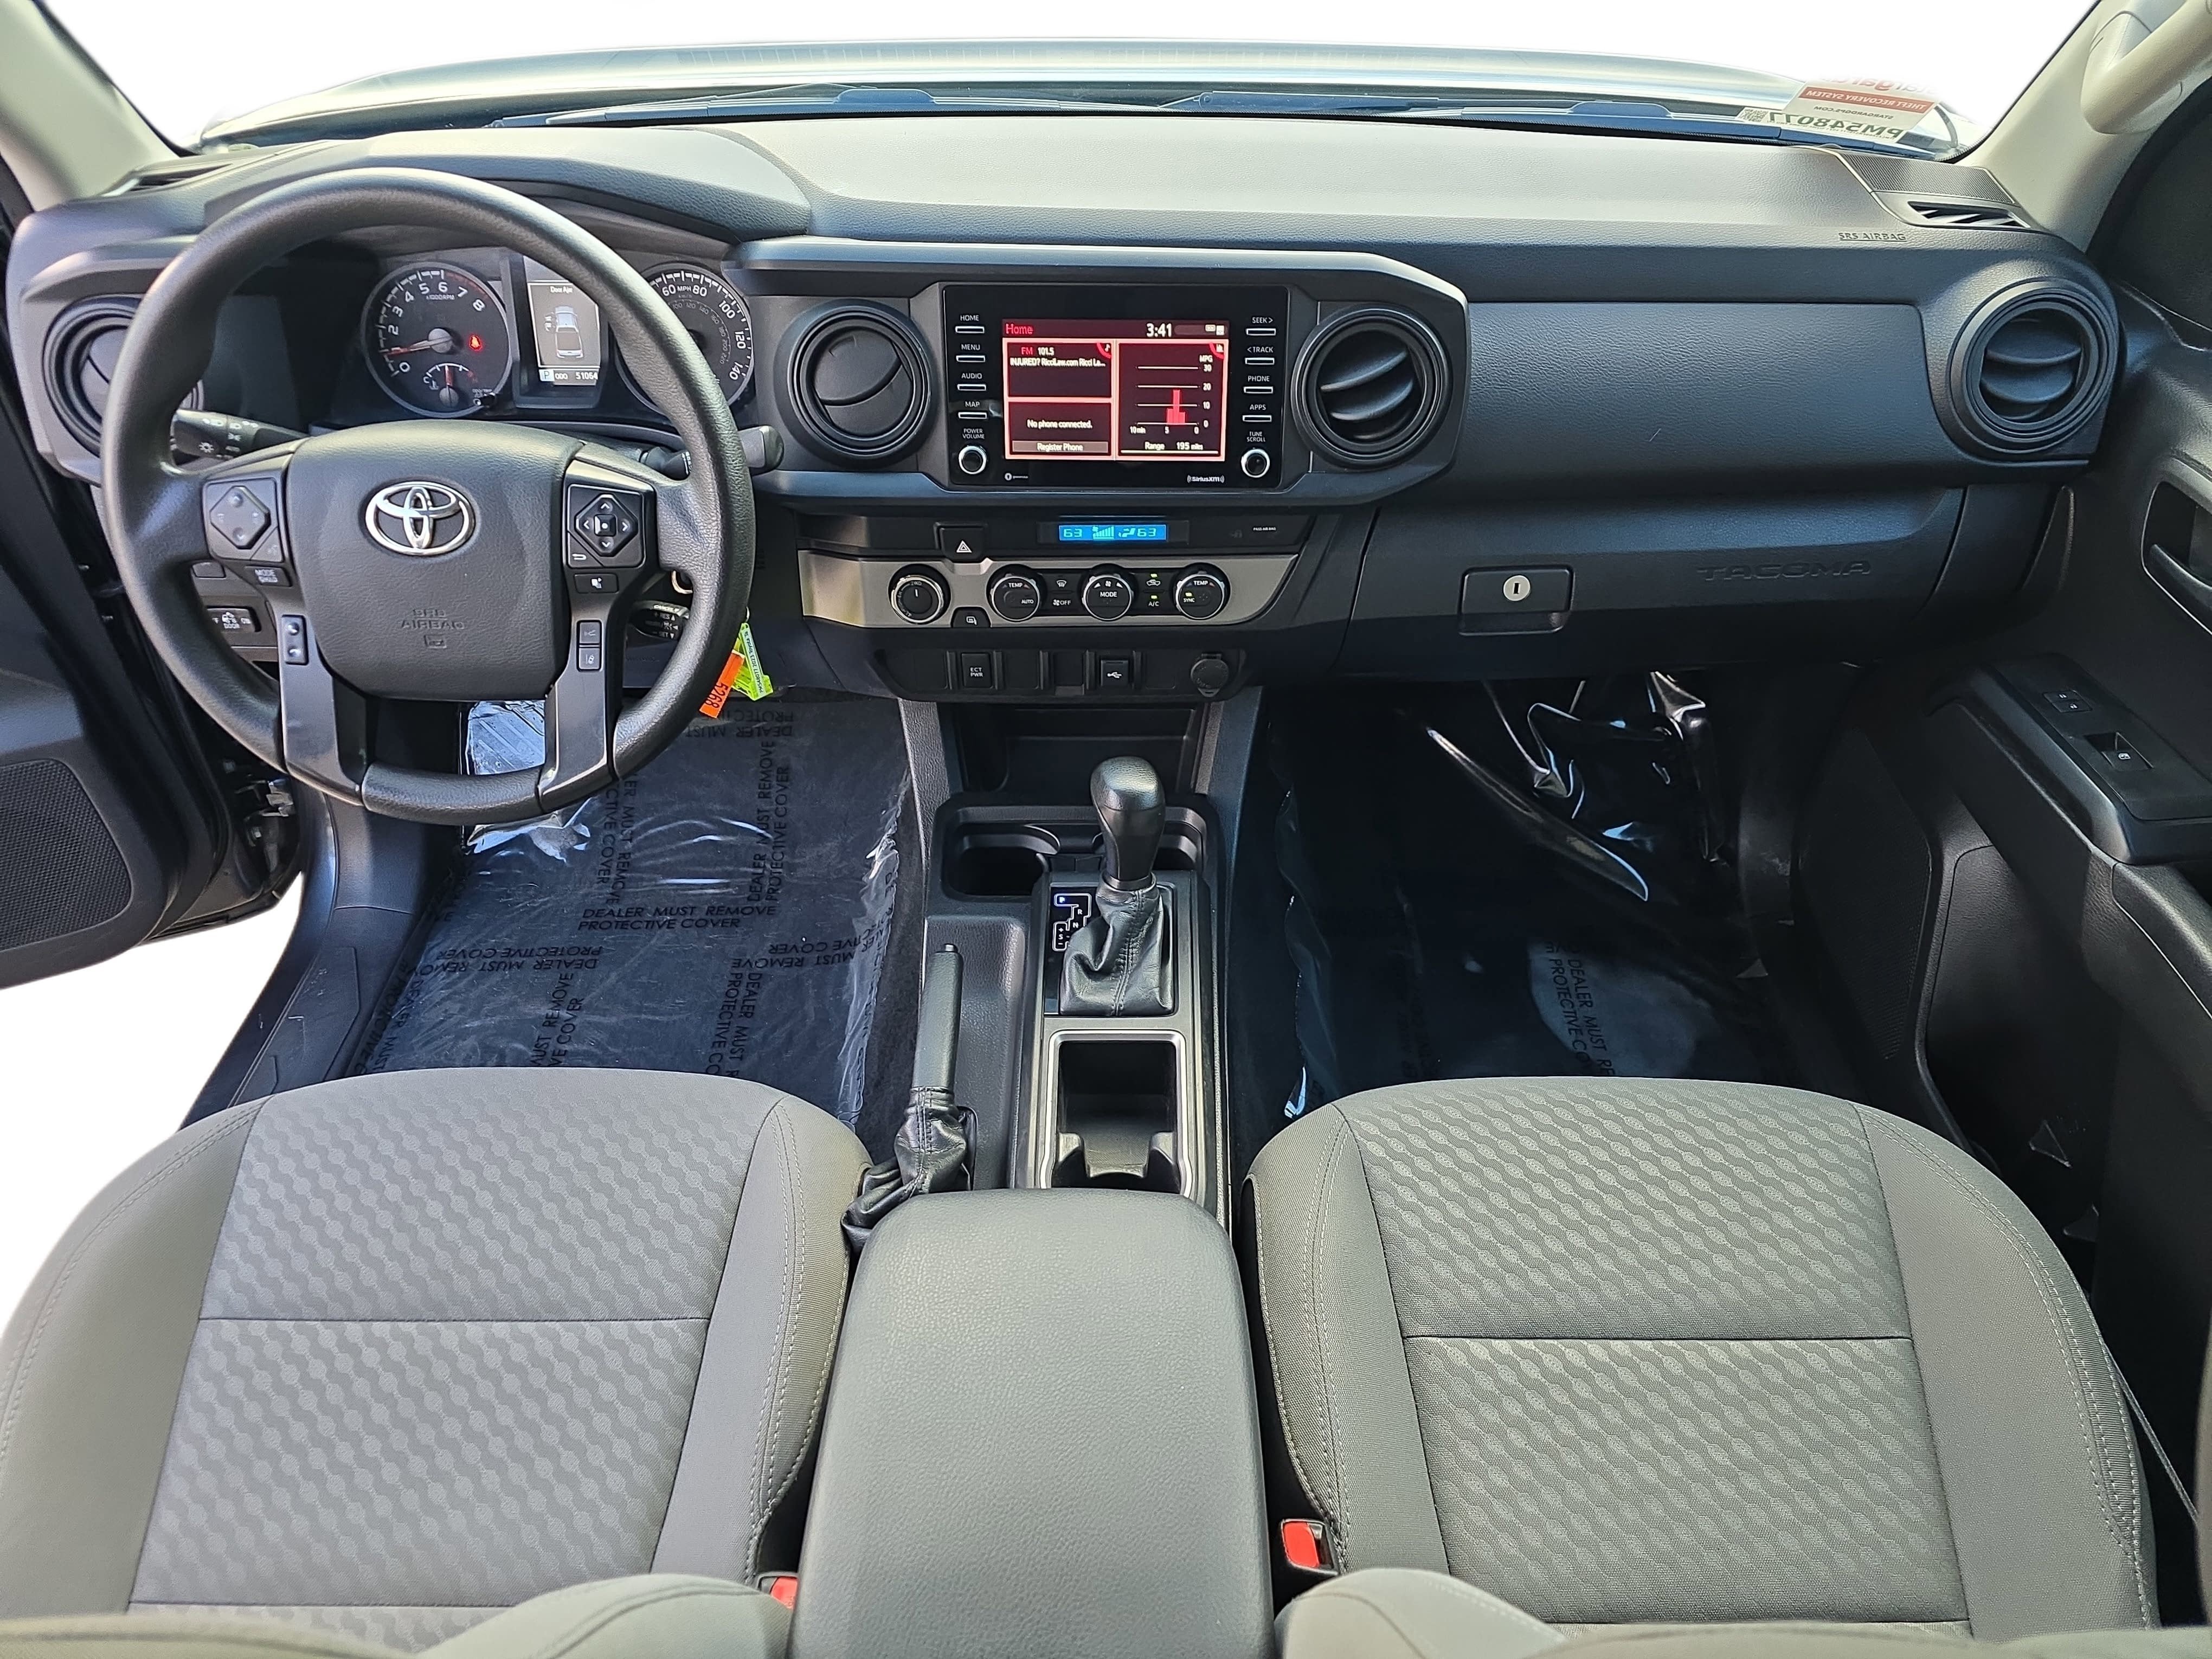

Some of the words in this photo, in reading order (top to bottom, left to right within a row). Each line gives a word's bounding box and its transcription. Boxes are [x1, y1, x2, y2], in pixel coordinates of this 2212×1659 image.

[419, 282, 430, 294] 5
[438, 281, 448, 292] 6
[457, 286, 468, 298] 7
[662, 284, 676, 297] 60
[692, 285, 708, 297] 80
[404, 291, 414, 303] 4
[472, 299, 485, 311] 8
[718, 300, 736, 319] 100
[392, 306, 403, 317] 3
[388, 324, 399, 335] 2
[1005, 323, 1033, 335] Home
[1146, 323, 1172, 338] 3:41
[735, 331, 747, 349] 120
[1021, 347, 1033, 355] FM
[1037, 347, 1054, 356] 101.5
[1009, 357, 1040, 366] INJURED?
[1199, 355, 1213, 363] MPG
[399, 362, 410, 372] 0
[729, 362, 743, 380] 140
[1203, 364, 1212, 372] 30
[544, 370, 550, 380] P
[576, 371, 598, 380] 51064
[1203, 383, 1212, 391] 20
[1203, 401, 1211, 409] 10
[1027, 420, 1037, 428] No
[1038, 420, 1058, 429] phone
[1058, 420, 1092, 428] connected.
[1203, 420, 1209, 428] 0
[1194, 427, 1200, 435] 0
[1037, 442, 1062, 452] Register
[1063, 443, 1083, 452] Phone
[1144, 441, 1165, 451] Range
[1176, 442, 1190, 450] 195
[1063, 528, 1082, 538] 63
[1137, 528, 1156, 537] 63
[1697, 560, 1870, 582] TACOMA
[401, 620, 465, 631] AIRBAG
[705, 683, 729, 709] 5268
[686, 726, 726, 738] MUST
[736, 725, 793, 738] DEALER
[758, 741, 774, 800] REMOVE
[775, 765, 790, 816] COVER
[756, 809, 770, 846] MUST
[596, 834, 616, 885] COVER
[766, 817, 788, 902] PROTECTIVE
[606, 852, 631, 904] REMOVE
[748, 853, 768, 902] DEALER
[581, 907, 644, 918] DEALER
[653, 906, 696, 916] MUST
[706, 906, 776, 916] REMOVE
[578, 919, 675, 930] PROTECTIVE
[680, 918, 741, 929] COVER
[437, 947, 497, 960] COVER
[501, 946, 603, 957] PROTECTIVE
[768, 942, 828, 954] COVER
[533, 958, 597, 970] DEALER
[732, 956, 805, 968] REMOVE
[814, 953, 856, 966] MUST
[478, 960, 522, 972] MUST
[542, 972, 573, 1028] REMOVE
[739, 972, 763, 1019] DEALER
[1549, 958, 1584, 1036] PROTECTIVE
[1567, 958, 1593, 1008] DEALER
[1583, 1015, 1609, 1051] MUST
[711, 973, 743, 1049] PROTECTIVE
[556, 996, 584, 1044] COVER
[728, 1025, 750, 1062] MUST
[372, 1034, 397, 1072] MUST
